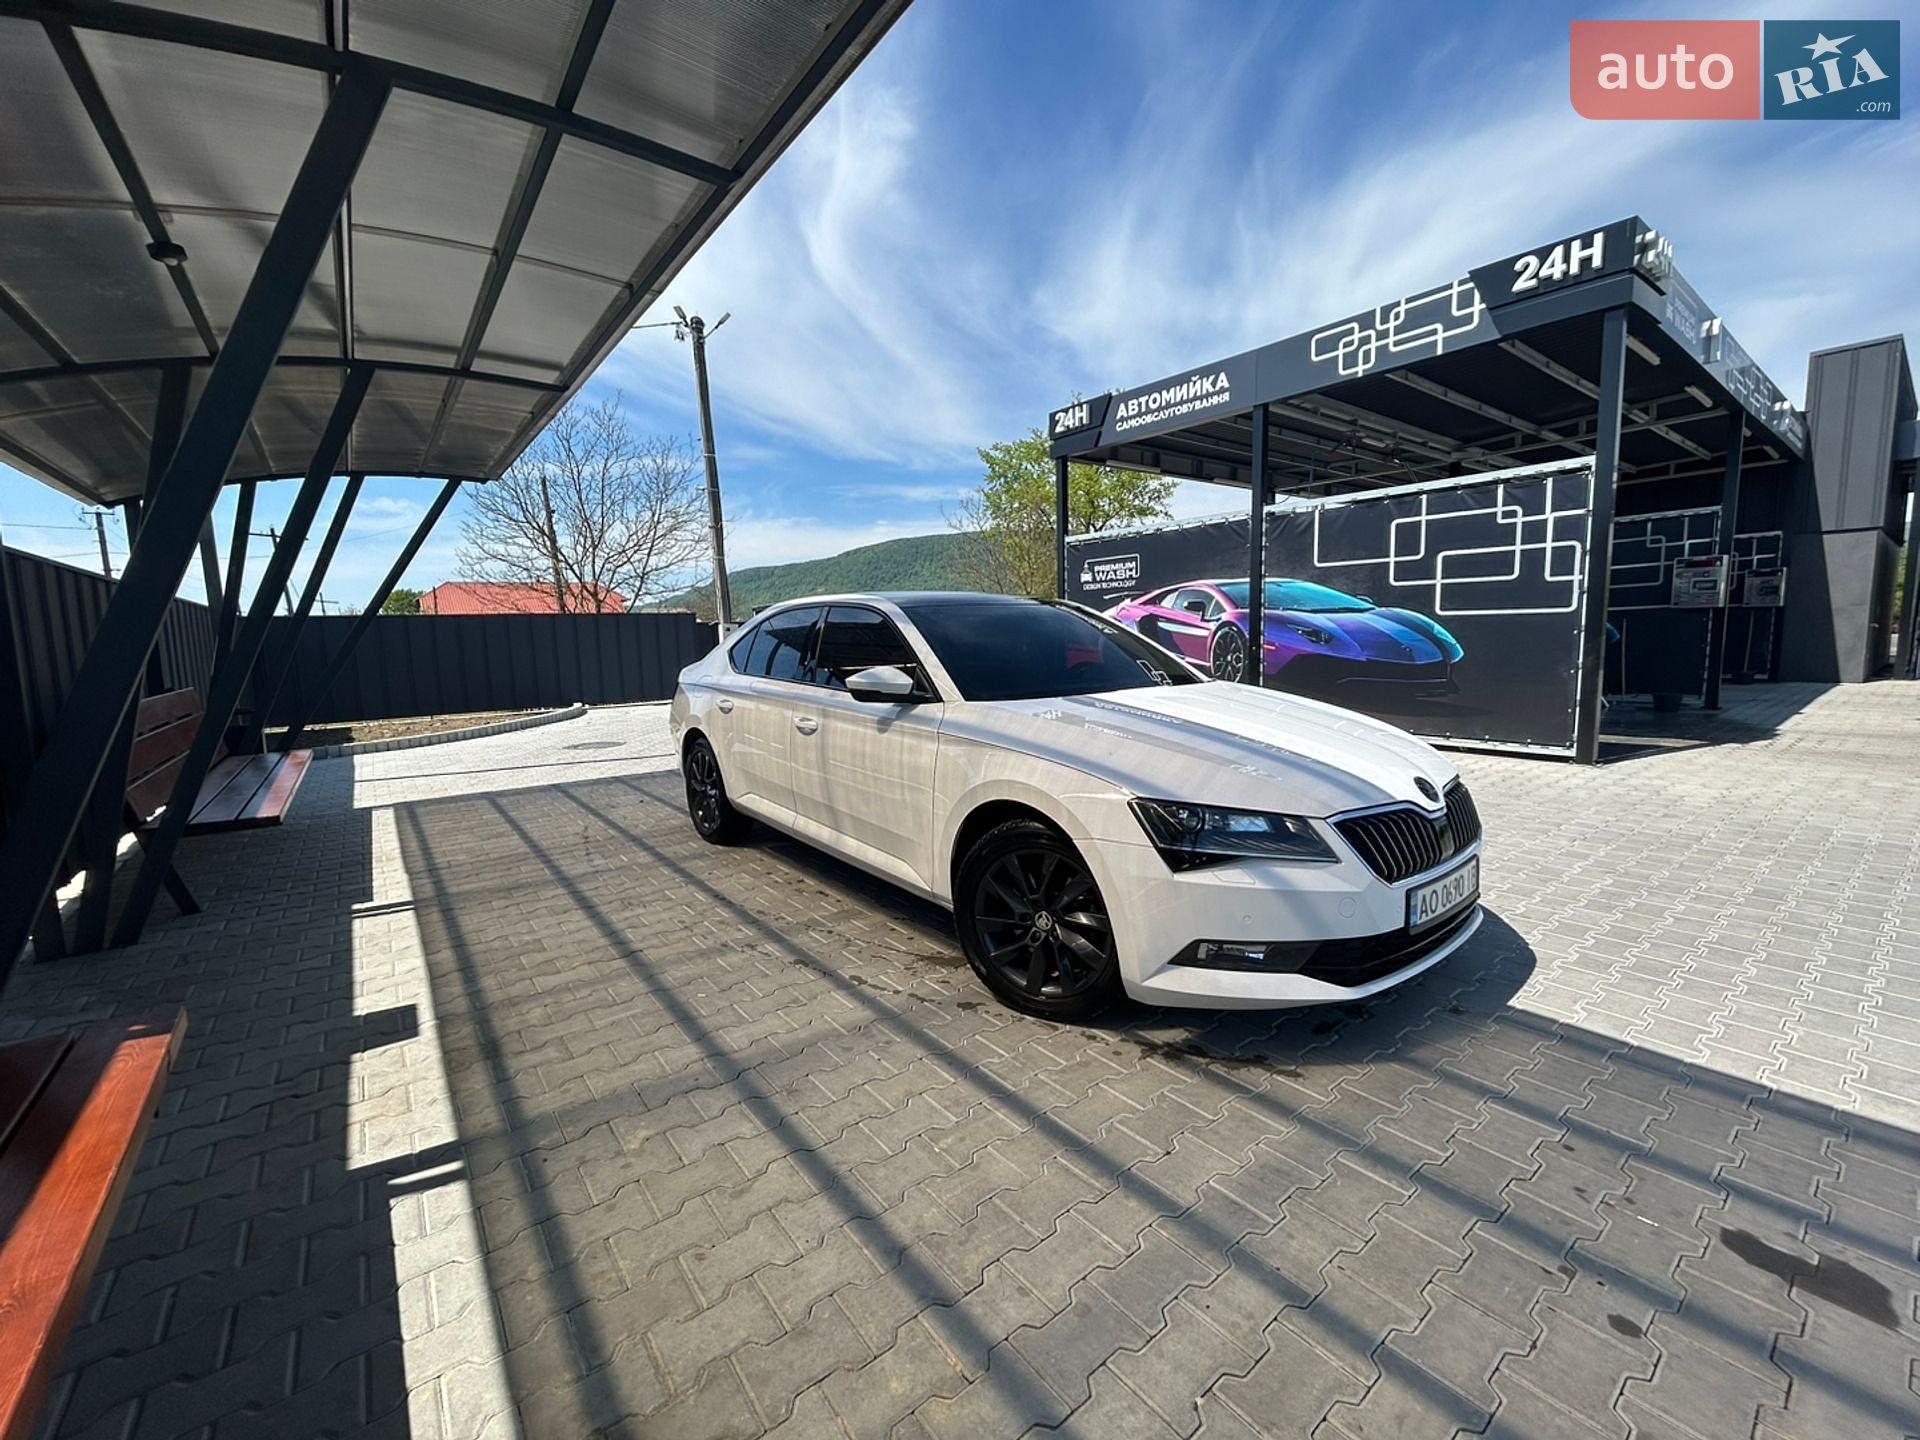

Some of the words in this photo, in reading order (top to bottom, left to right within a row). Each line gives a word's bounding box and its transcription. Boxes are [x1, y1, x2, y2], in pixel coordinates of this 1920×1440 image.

[1511, 231, 1605, 295] 24H
[1115, 371, 1231, 420] АВТОМИЙКА
[1115, 391, 1231, 432] САМООБСЛУГОВУВАННЯ
[1054, 403, 1090, 434] 24H
[1094, 561, 1136, 571] PREMIUM
[1095, 569, 1136, 581] WASH
